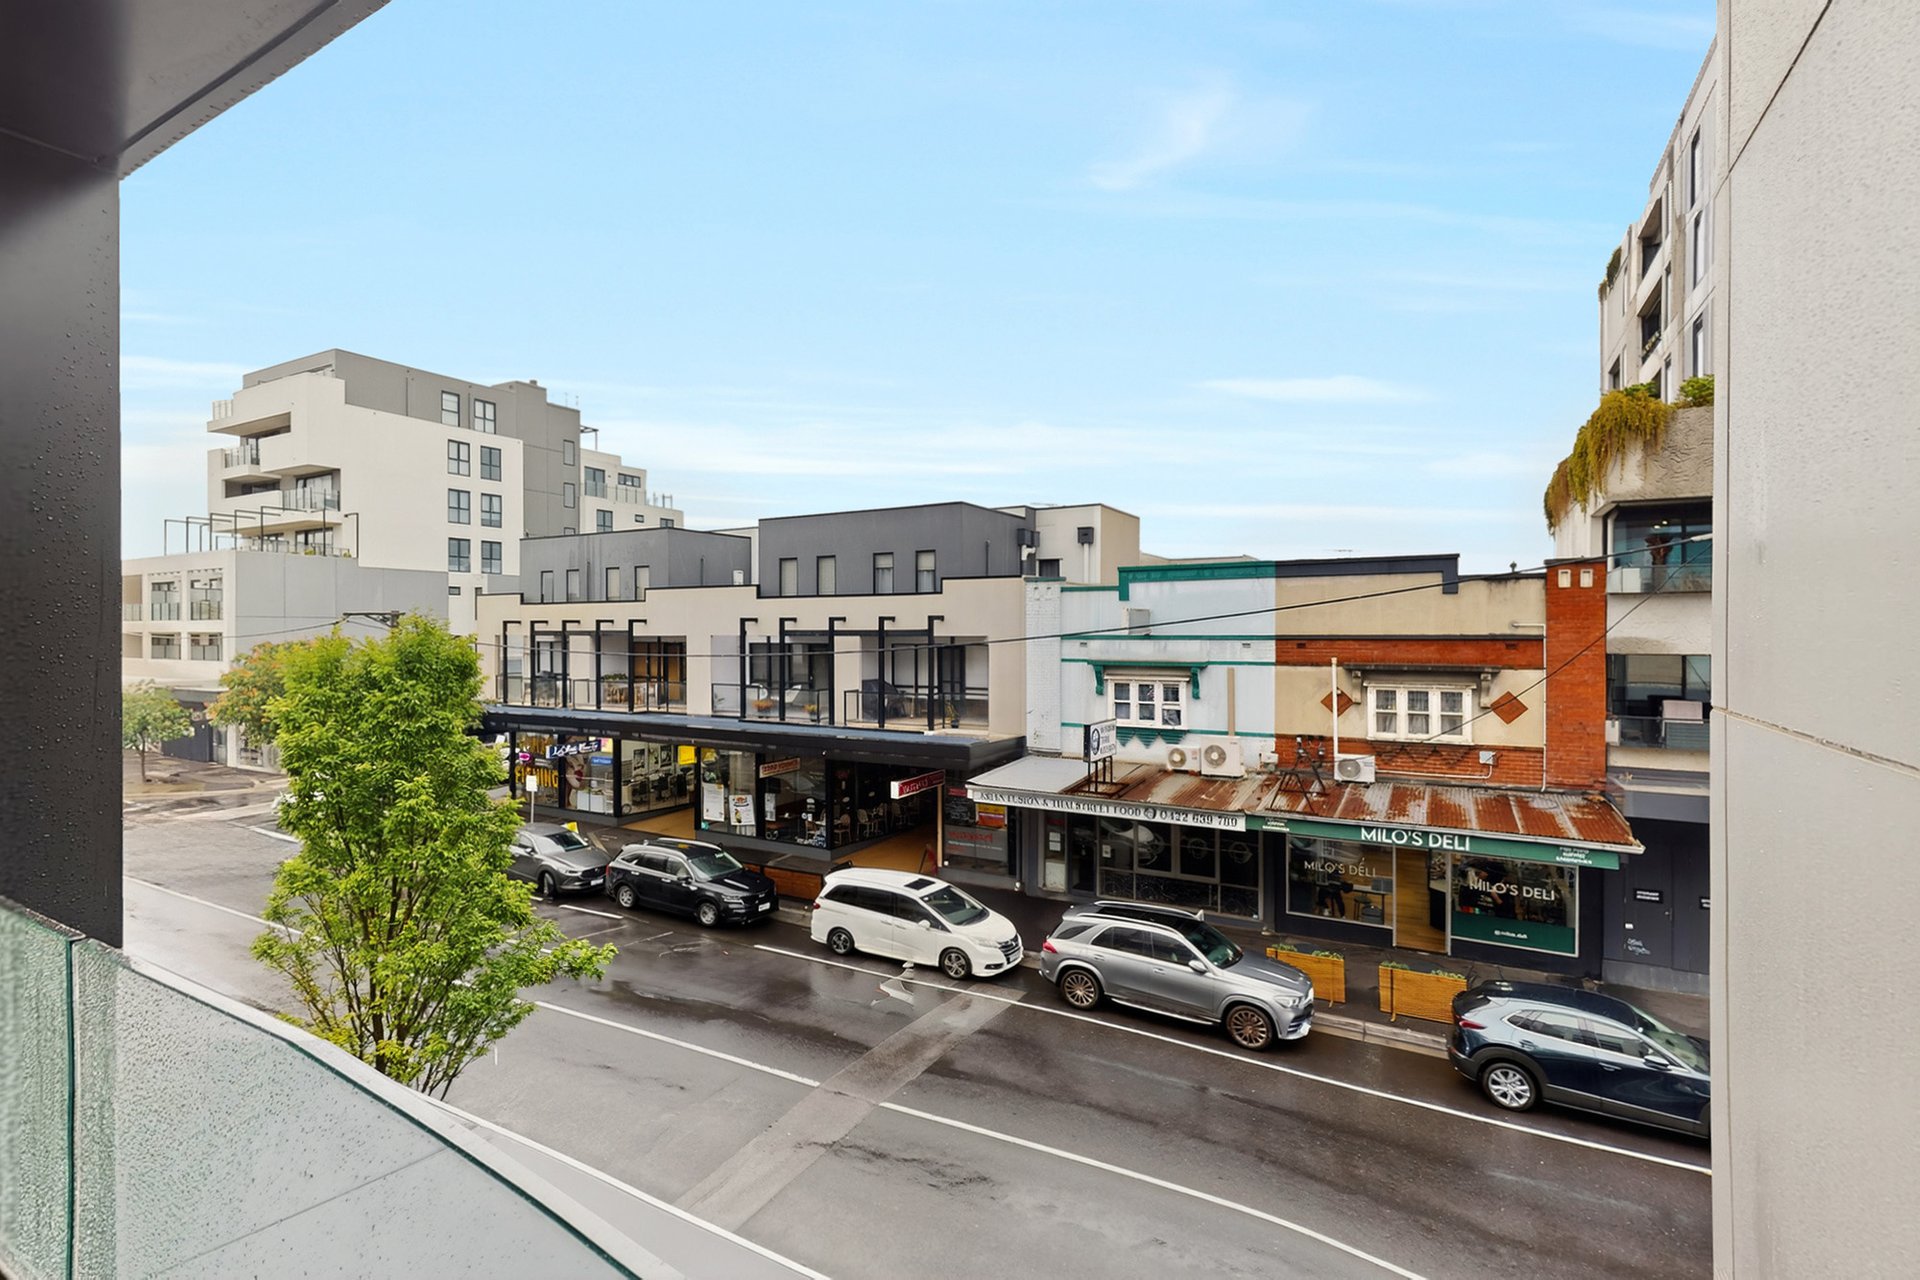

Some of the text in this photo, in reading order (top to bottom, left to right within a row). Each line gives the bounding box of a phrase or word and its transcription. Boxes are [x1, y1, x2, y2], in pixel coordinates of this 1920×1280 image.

[1042, 798, 1049, 807] &
[1113, 804, 1142, 817] FOOD
[1361, 826, 1470, 851] MILO'S DELI
[1303, 860, 1346, 874] MILO'S
[1469, 879, 1556, 901] MILO'S DELI
